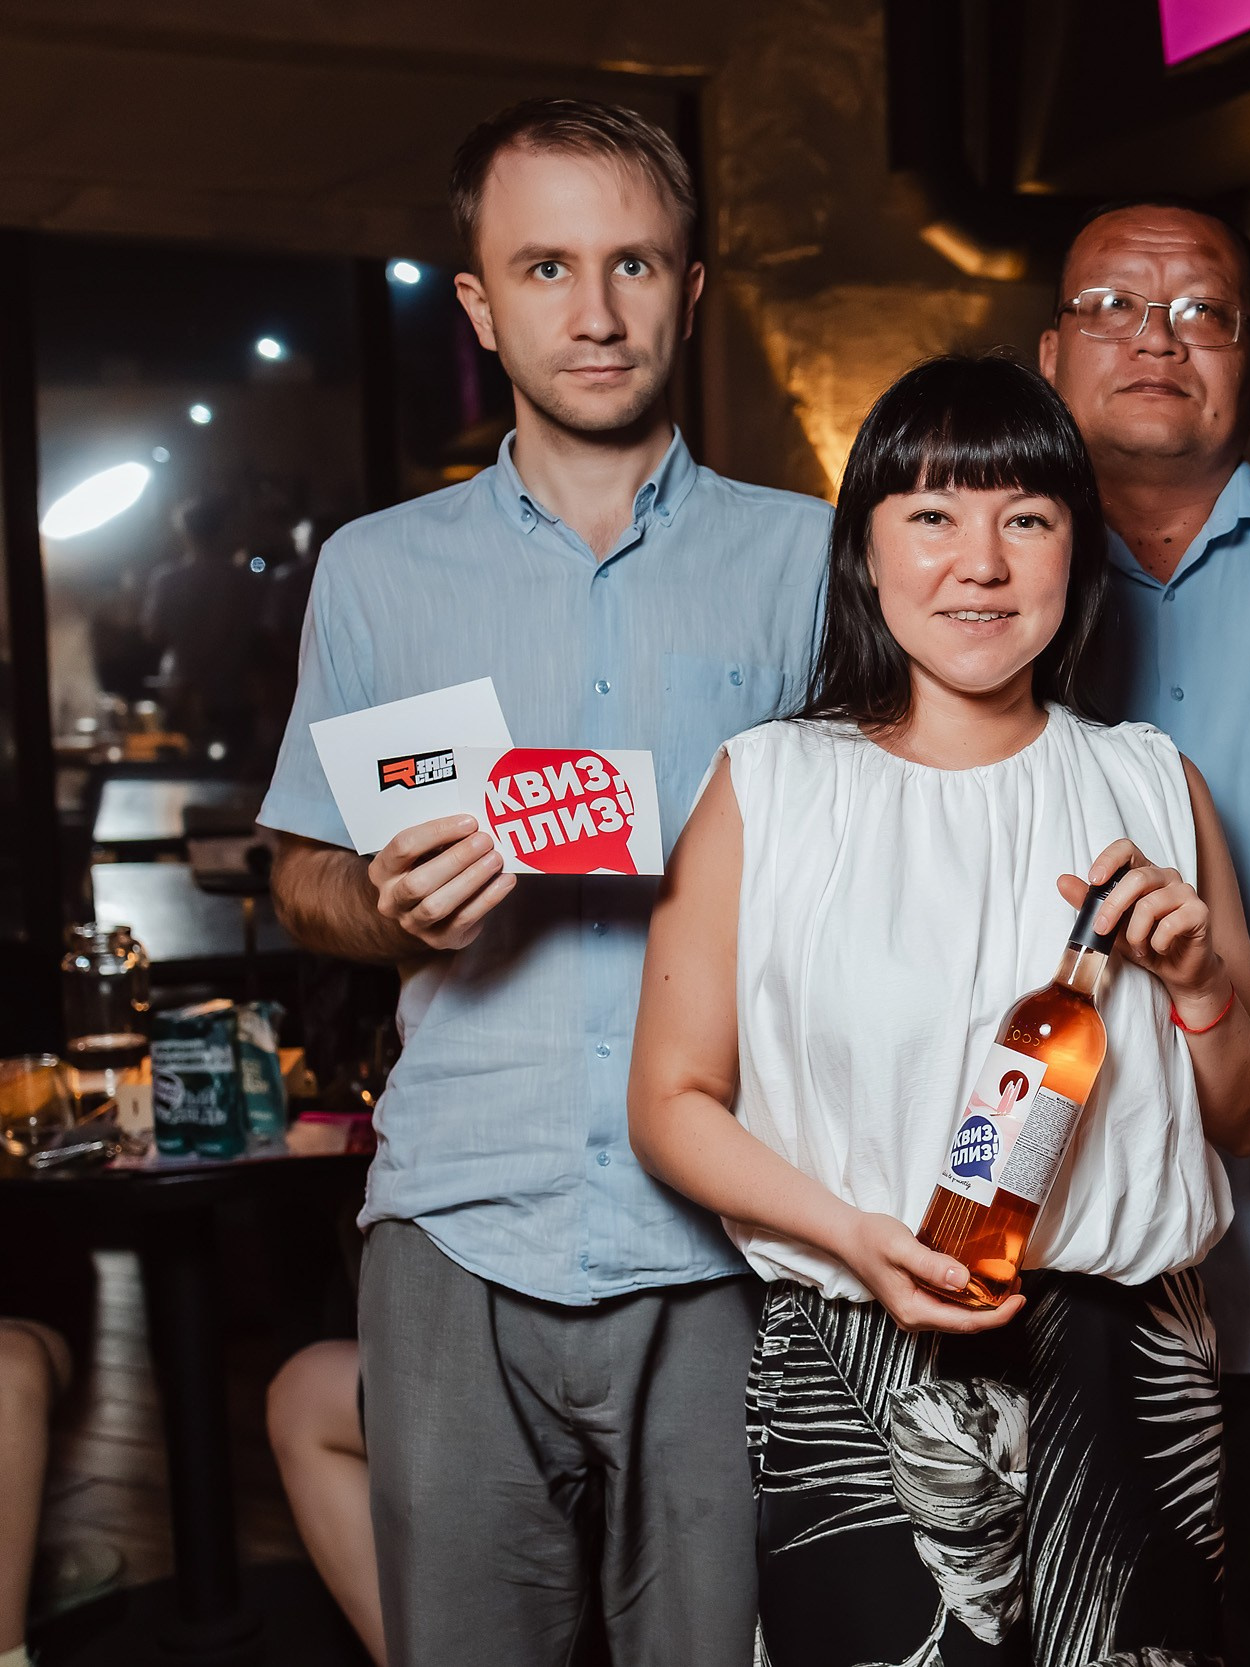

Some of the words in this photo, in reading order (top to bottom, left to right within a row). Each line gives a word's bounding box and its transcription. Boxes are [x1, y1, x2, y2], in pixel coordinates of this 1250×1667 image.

[415, 767, 453, 785] CLUB
[486, 756, 627, 816] КВИЗ,
[494, 792, 635, 856] ПЛИЗ!
[953, 1124, 998, 1150] КВИЗ,
[951, 1143, 998, 1167] ПЛИЗ!
